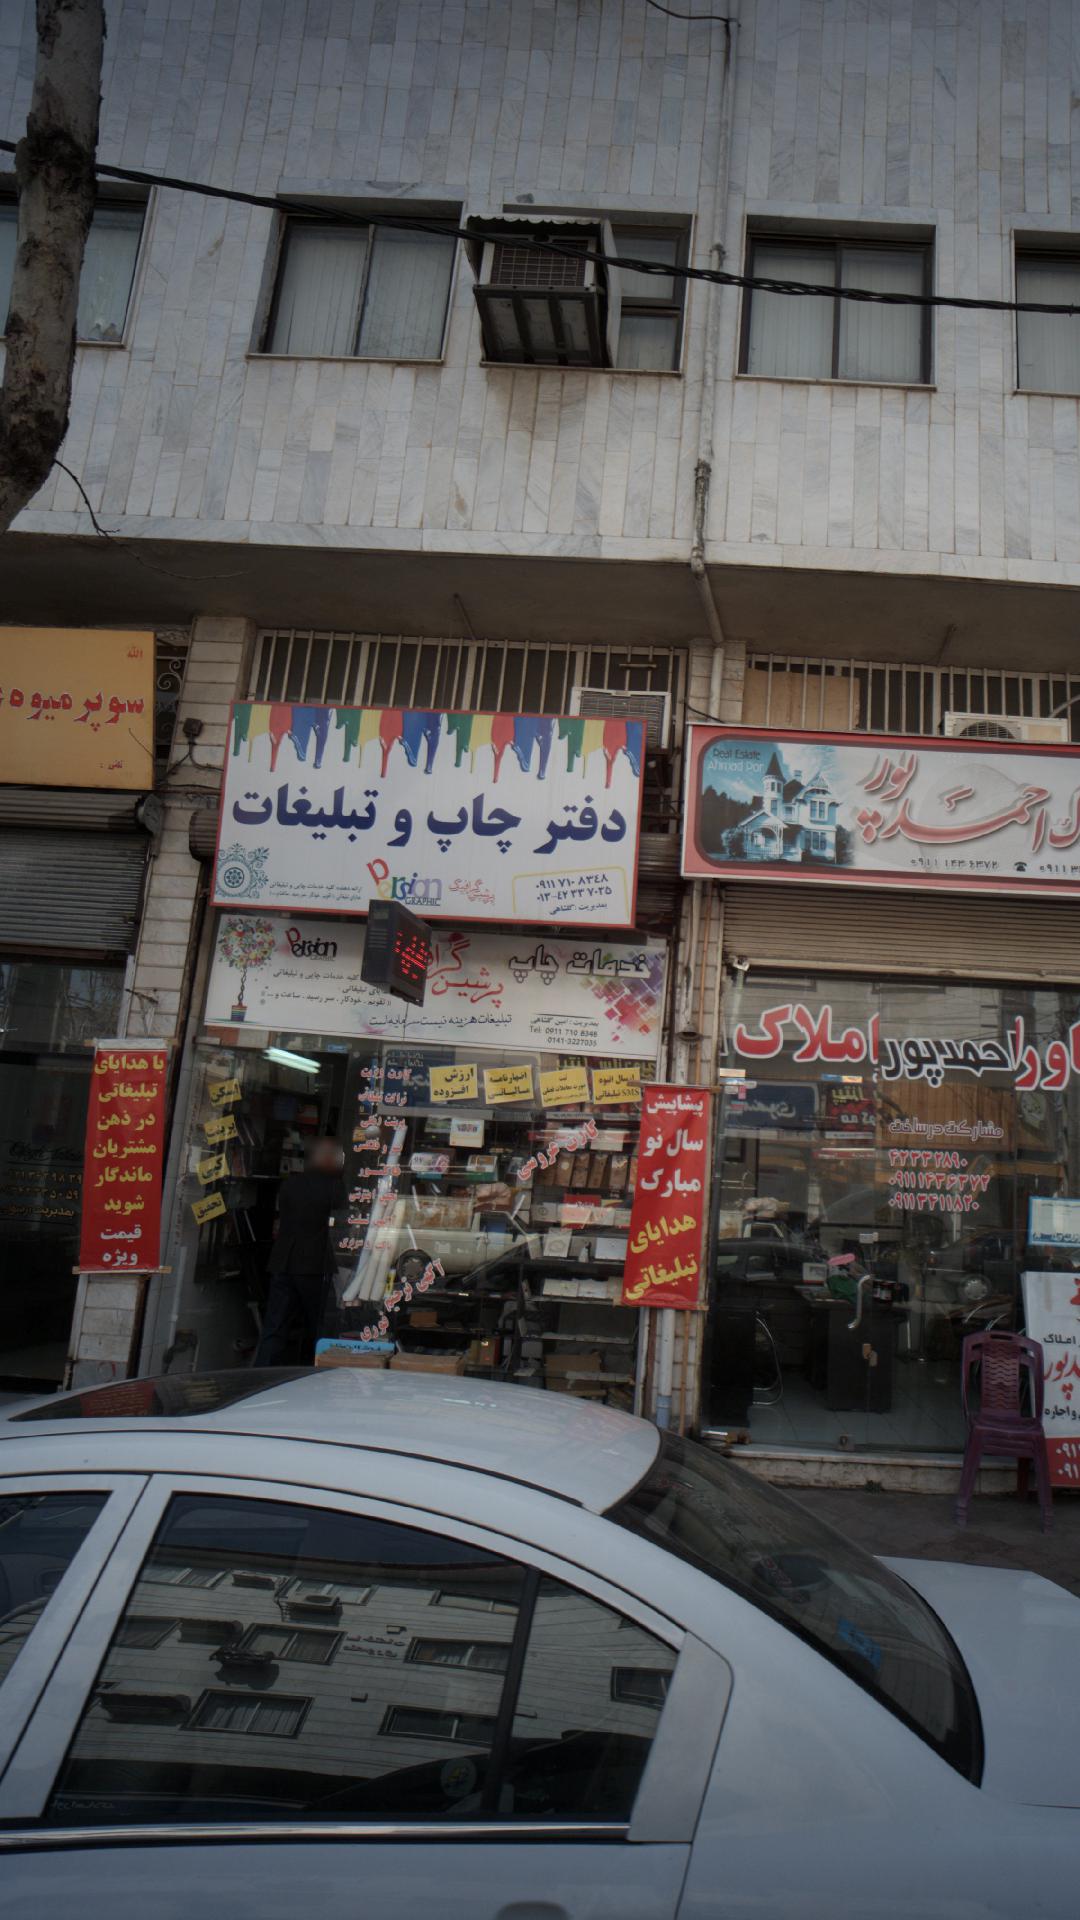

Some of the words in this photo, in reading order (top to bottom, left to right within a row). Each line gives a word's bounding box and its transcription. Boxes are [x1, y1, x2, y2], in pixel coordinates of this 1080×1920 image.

[73, 692, 144, 732] سوپر
[712, 748, 732, 758] Real
[735, 749, 760, 759] Estate
[708, 761, 744, 772] Ahmad
[747, 762, 764, 773] Por
[232, 783, 379, 843] تبلیغات
[427, 793, 521, 854] چاپ
[387, 808, 413, 847] و
[533, 795, 627, 854] دفتر
[367, 858, 441, 901] Persian
[405, 897, 442, 907] GRAPHIC
[285, 927, 338, 958] Persian
[508, 944, 560, 986] چاپ
[566, 949, 654, 980] خدمات
[432, 968, 503, 1009] پرشین
[420, 1015, 447, 1029] نیست
[448, 1014, 478, 1028] هزینه
[477, 1013, 512, 1027] تبلیغات
[546, 1027, 563, 1036] 0911
[94, 1055, 149, 1075] هدایای
[153, 1055, 165, 1075] با
[881, 1029, 1020, 1087] احمدپور
[444, 1068, 475, 1083] ارزش
[98, 1082, 159, 1103] تبلیغاتی
[433, 1085, 469, 1099] افزوده
[622, 1088, 640, 1098] SMS
[646, 1094, 704, 1118] پیشاپیش
[97, 1110, 131, 1131] ذهن
[135, 1113, 156, 1131] در
[92, 1138, 157, 1159] مشتریان
[642, 1127, 663, 1158] نو
[666, 1128, 704, 1158] سال
[94, 1166, 153, 1187] ماندگار
[640, 1168, 702, 1198] مبارک
[104, 1194, 145, 1216] شوید
[100, 1223, 142, 1243] قیمت
[630, 1215, 697, 1254] هدایای
[102, 1249, 138, 1267] ویژه
[625, 1253, 698, 1300] تبلیغاتی
[1043, 1334, 1077, 1345] املاک
[1043, 1405, 1070, 1420] اجاره
